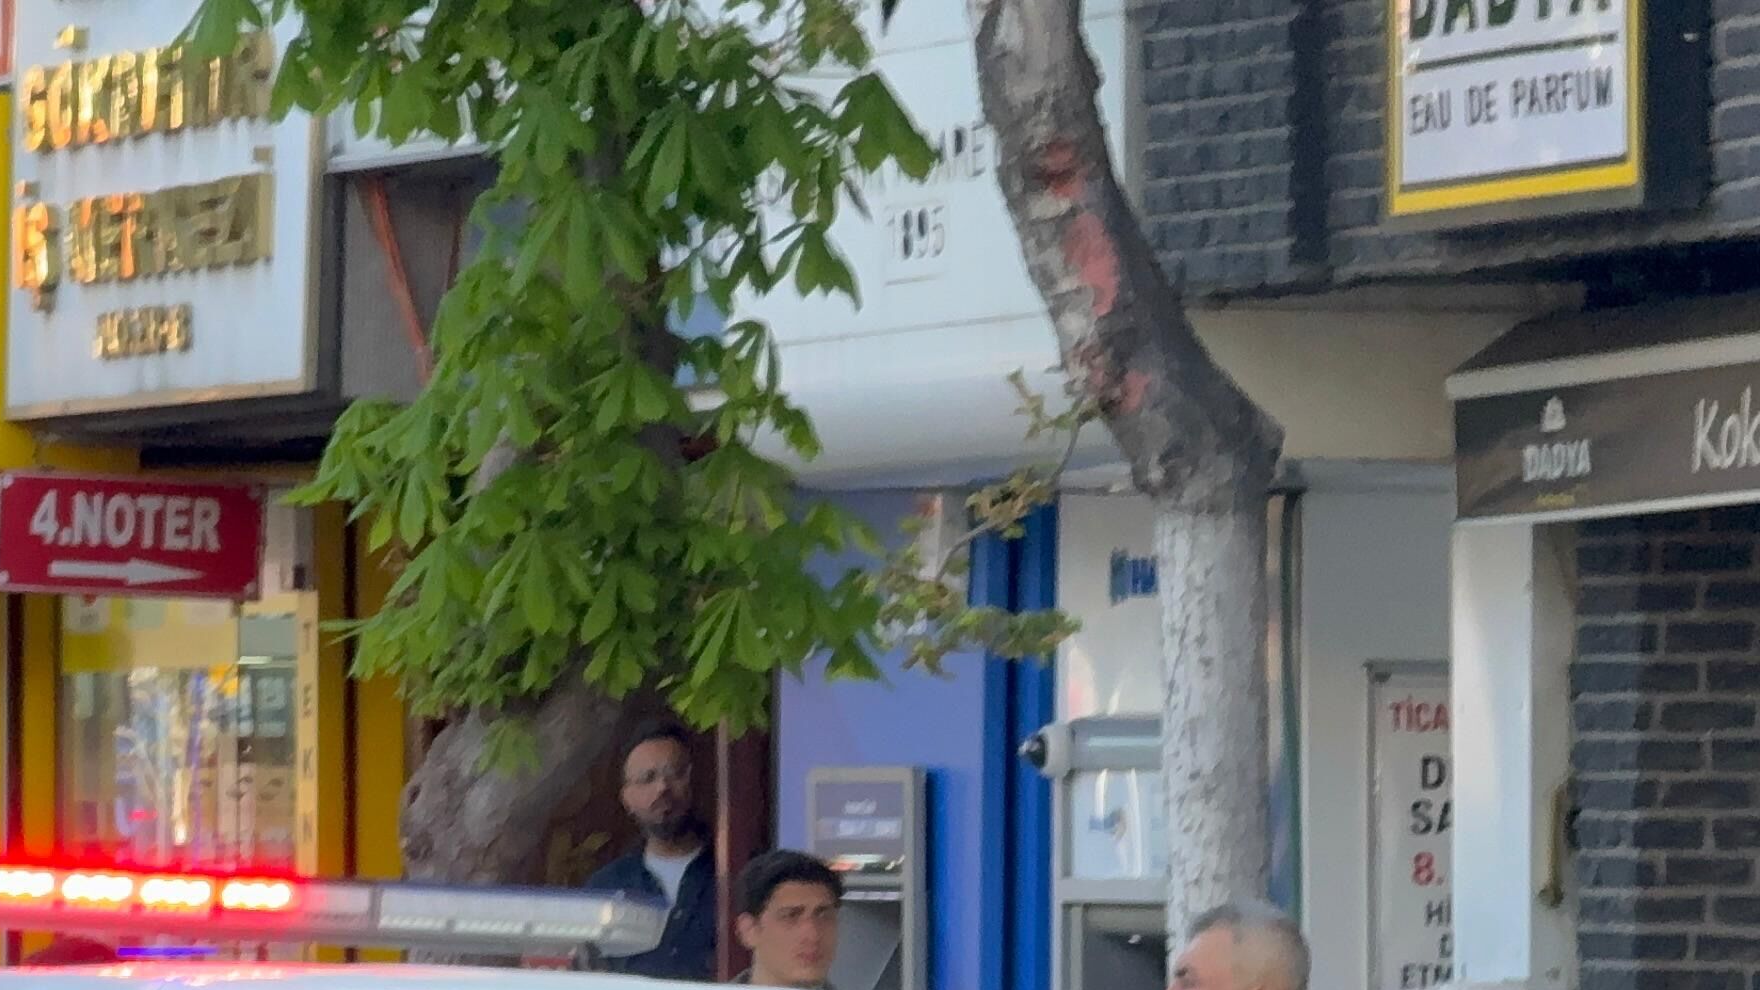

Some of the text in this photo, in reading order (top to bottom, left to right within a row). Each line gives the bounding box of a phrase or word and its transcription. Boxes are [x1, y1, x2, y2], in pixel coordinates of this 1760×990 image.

[1409, 66, 1613, 136] EAU DE PARFUM
[886, 205, 946, 262] 1895
[1523, 438, 1591, 483] DADYA
[30, 488, 222, 552] 4.NOTER
